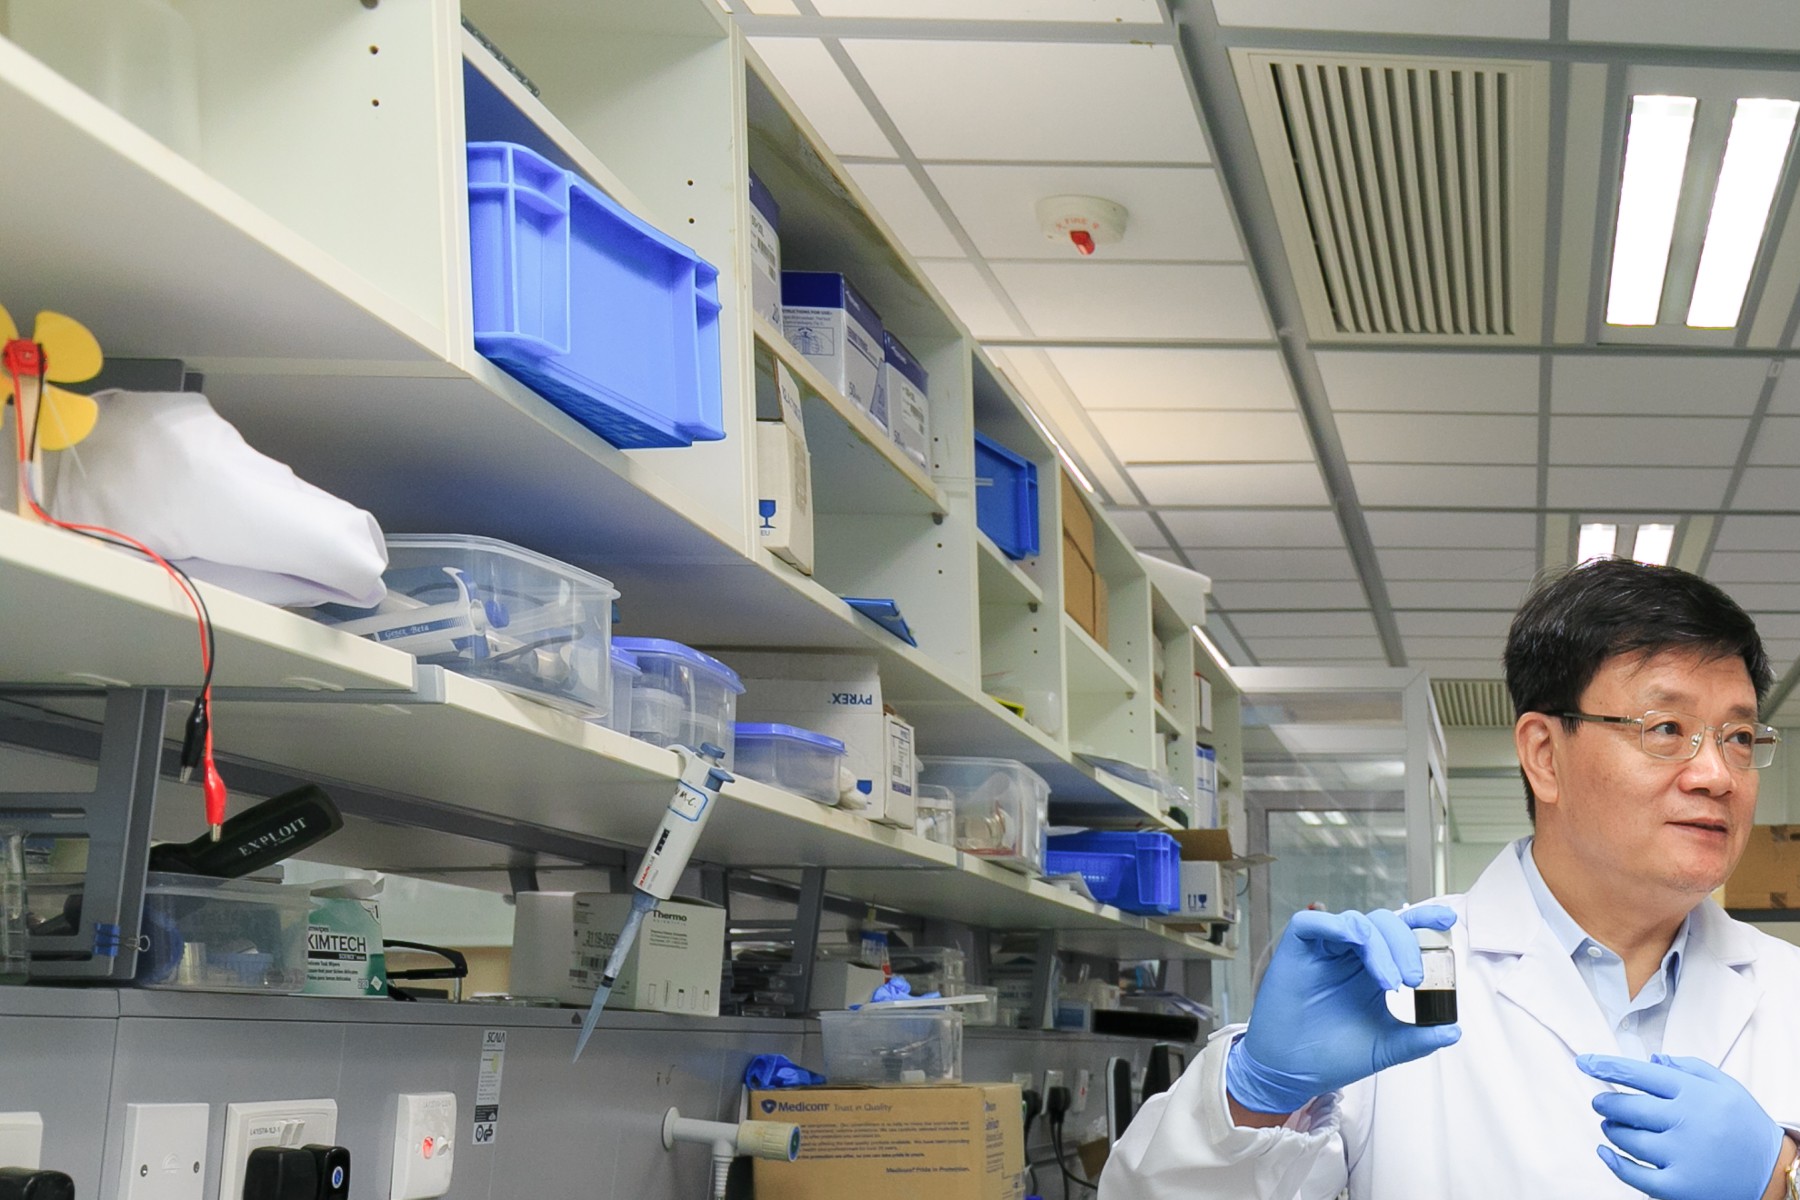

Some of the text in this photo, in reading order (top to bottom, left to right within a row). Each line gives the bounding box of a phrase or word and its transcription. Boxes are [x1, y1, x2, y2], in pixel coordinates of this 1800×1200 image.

[832, 693, 873, 706] PYREX
[238, 817, 306, 856] EXPLOIT
[653, 909, 688, 922] Thermo
[308, 933, 367, 953] KIMTECH
[834, 1103, 853, 1112] Trust
[864, 1103, 893, 1113] Quality
